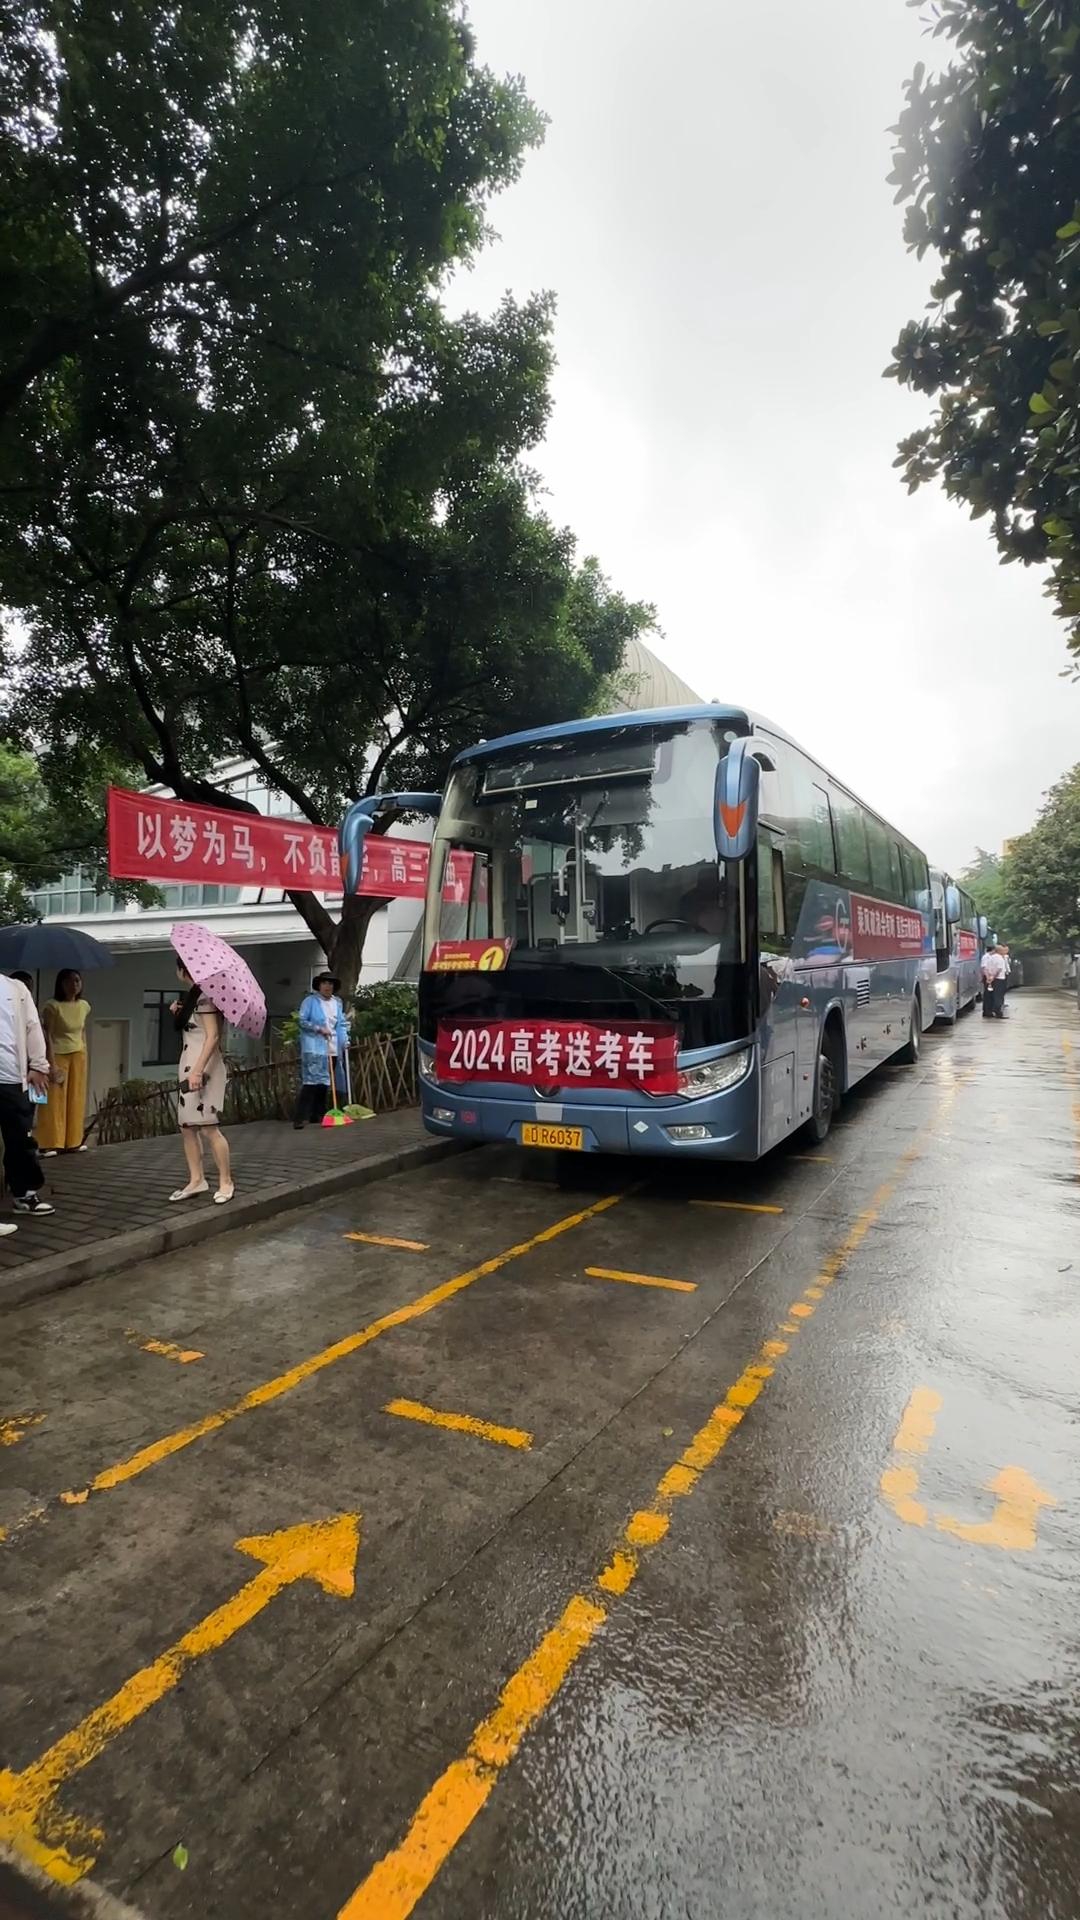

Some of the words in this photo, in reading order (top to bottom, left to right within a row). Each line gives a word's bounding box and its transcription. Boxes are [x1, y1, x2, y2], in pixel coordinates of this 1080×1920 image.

[449, 1029, 655, 1080] 2024高考送考车
